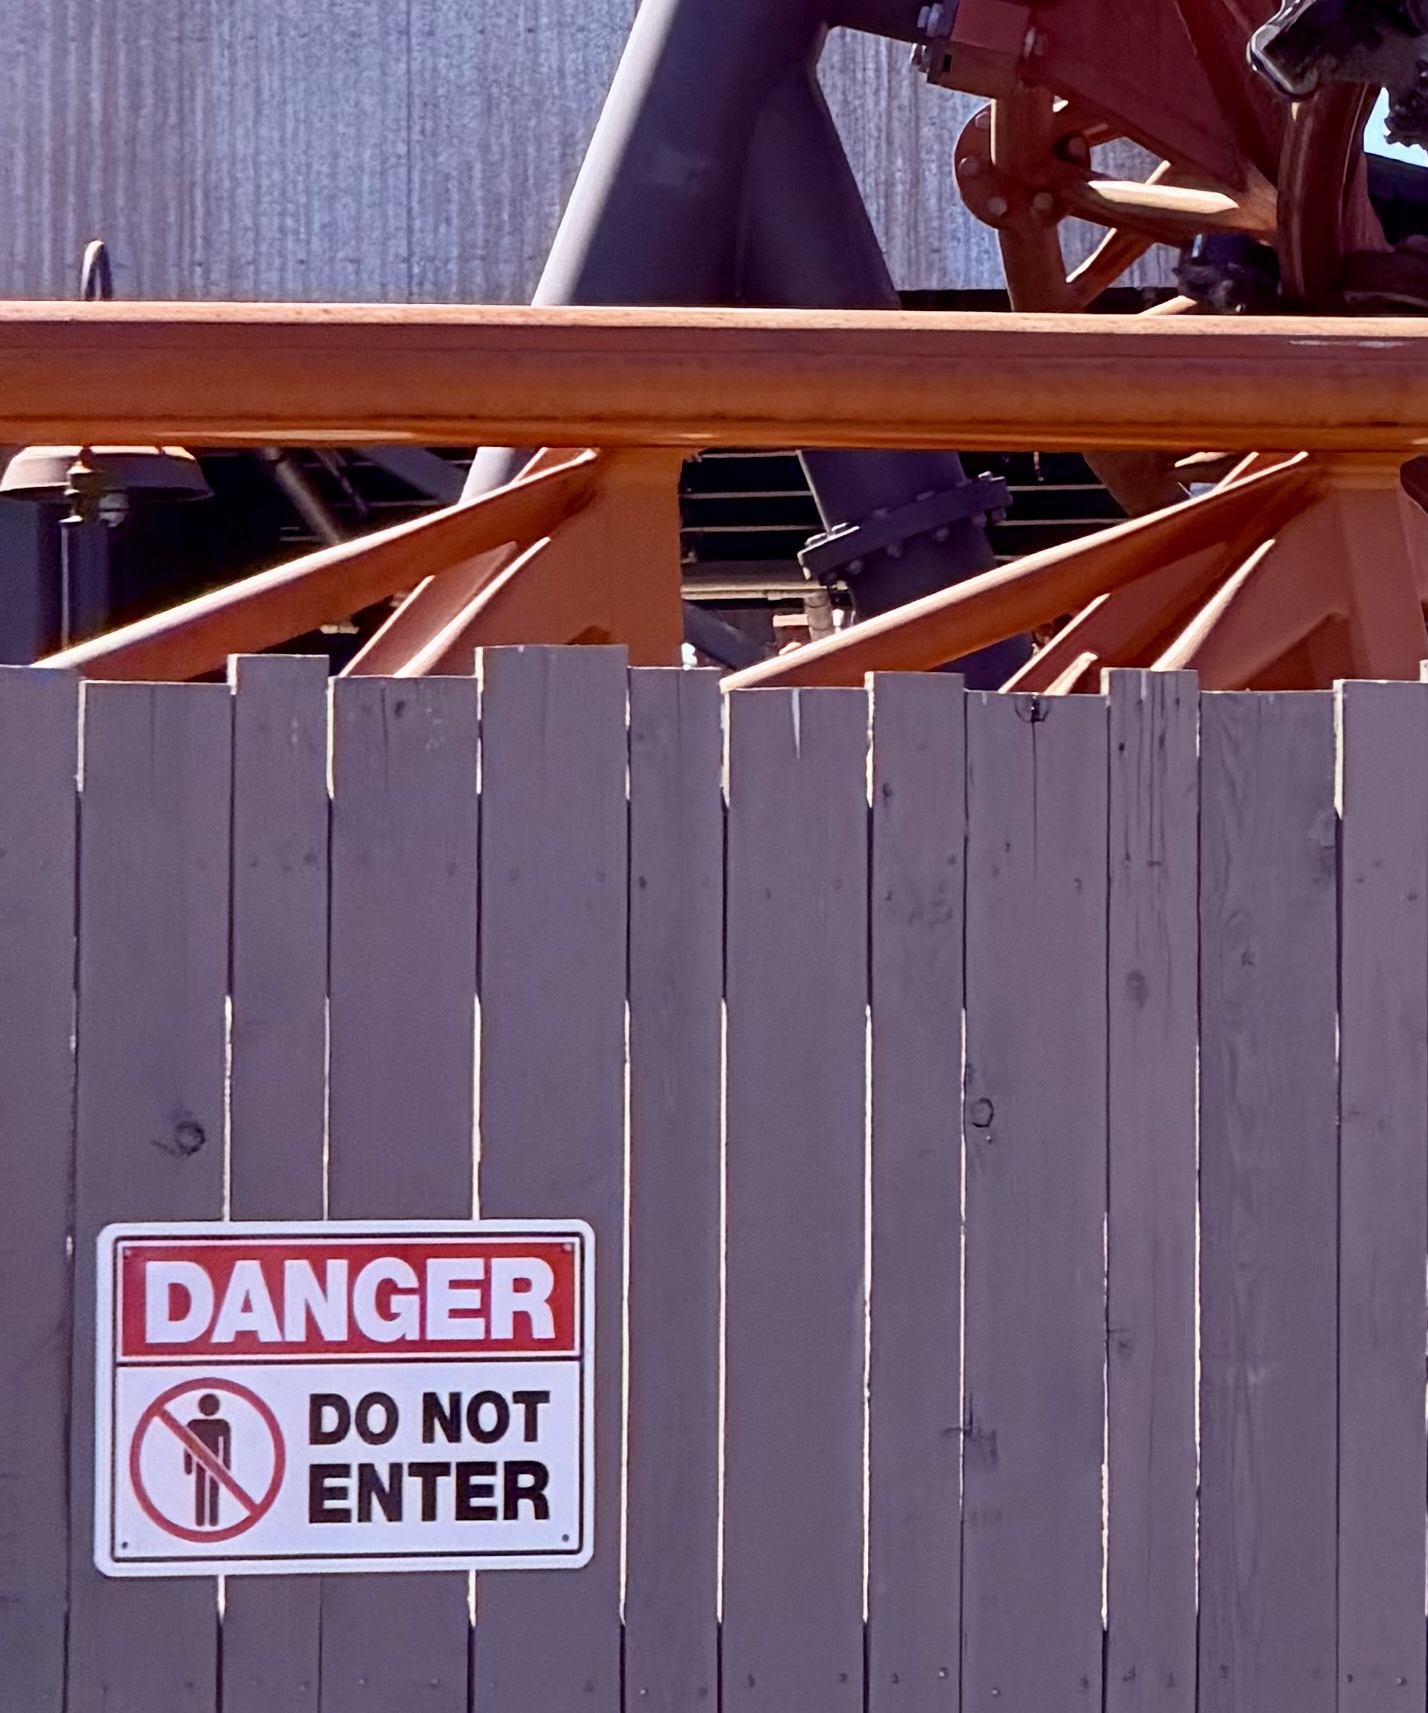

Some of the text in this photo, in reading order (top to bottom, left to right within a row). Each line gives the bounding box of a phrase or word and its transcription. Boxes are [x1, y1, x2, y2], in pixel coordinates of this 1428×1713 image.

[145, 1256, 556, 1344] DANGER
[309, 1390, 550, 1446] DO NOT
[308, 1460, 550, 1524] ENTER
